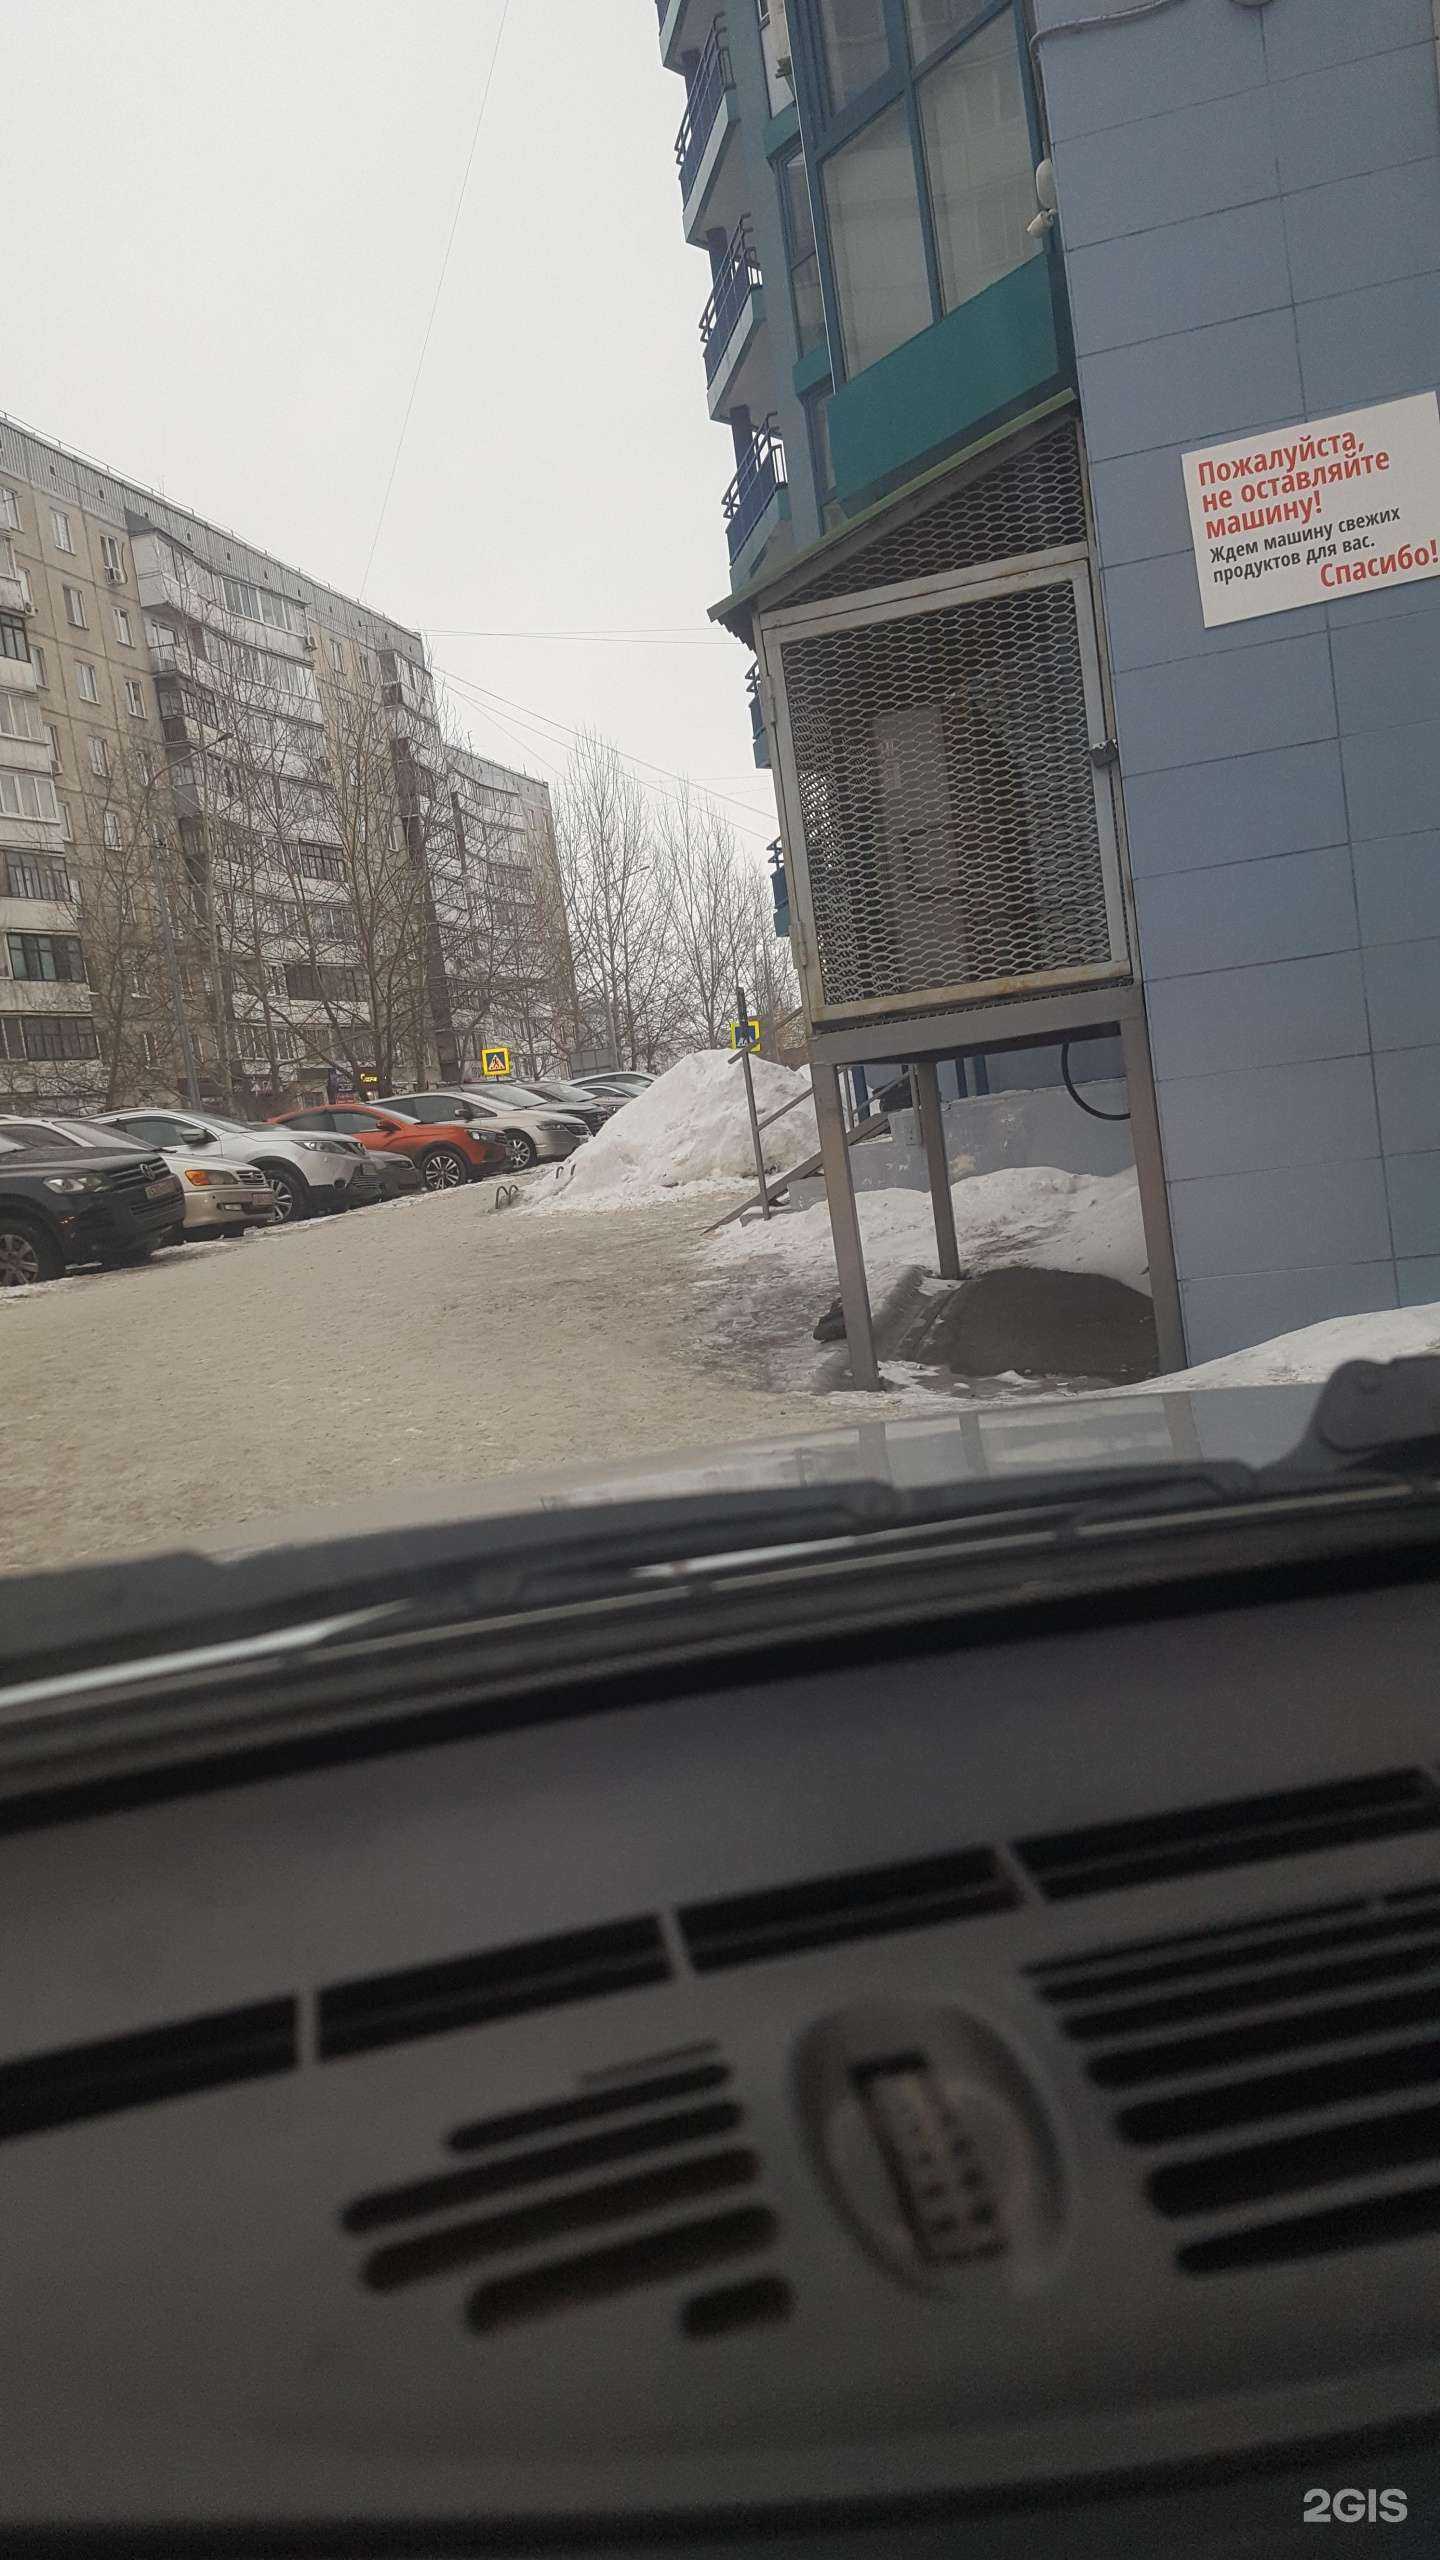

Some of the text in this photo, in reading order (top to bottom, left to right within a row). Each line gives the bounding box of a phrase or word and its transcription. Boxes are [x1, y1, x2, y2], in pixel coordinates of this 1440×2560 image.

[1198, 431, 1364, 486] Пожалуйста,
[1202, 451, 1390, 513] не оставляйте
[1205, 490, 1322, 539] машину!
[1210, 507, 1401, 563] Ждем машину свежих
[1213, 535, 1375, 584] продуктов для вас.
[1320, 539, 1438, 588] Спасибо!
